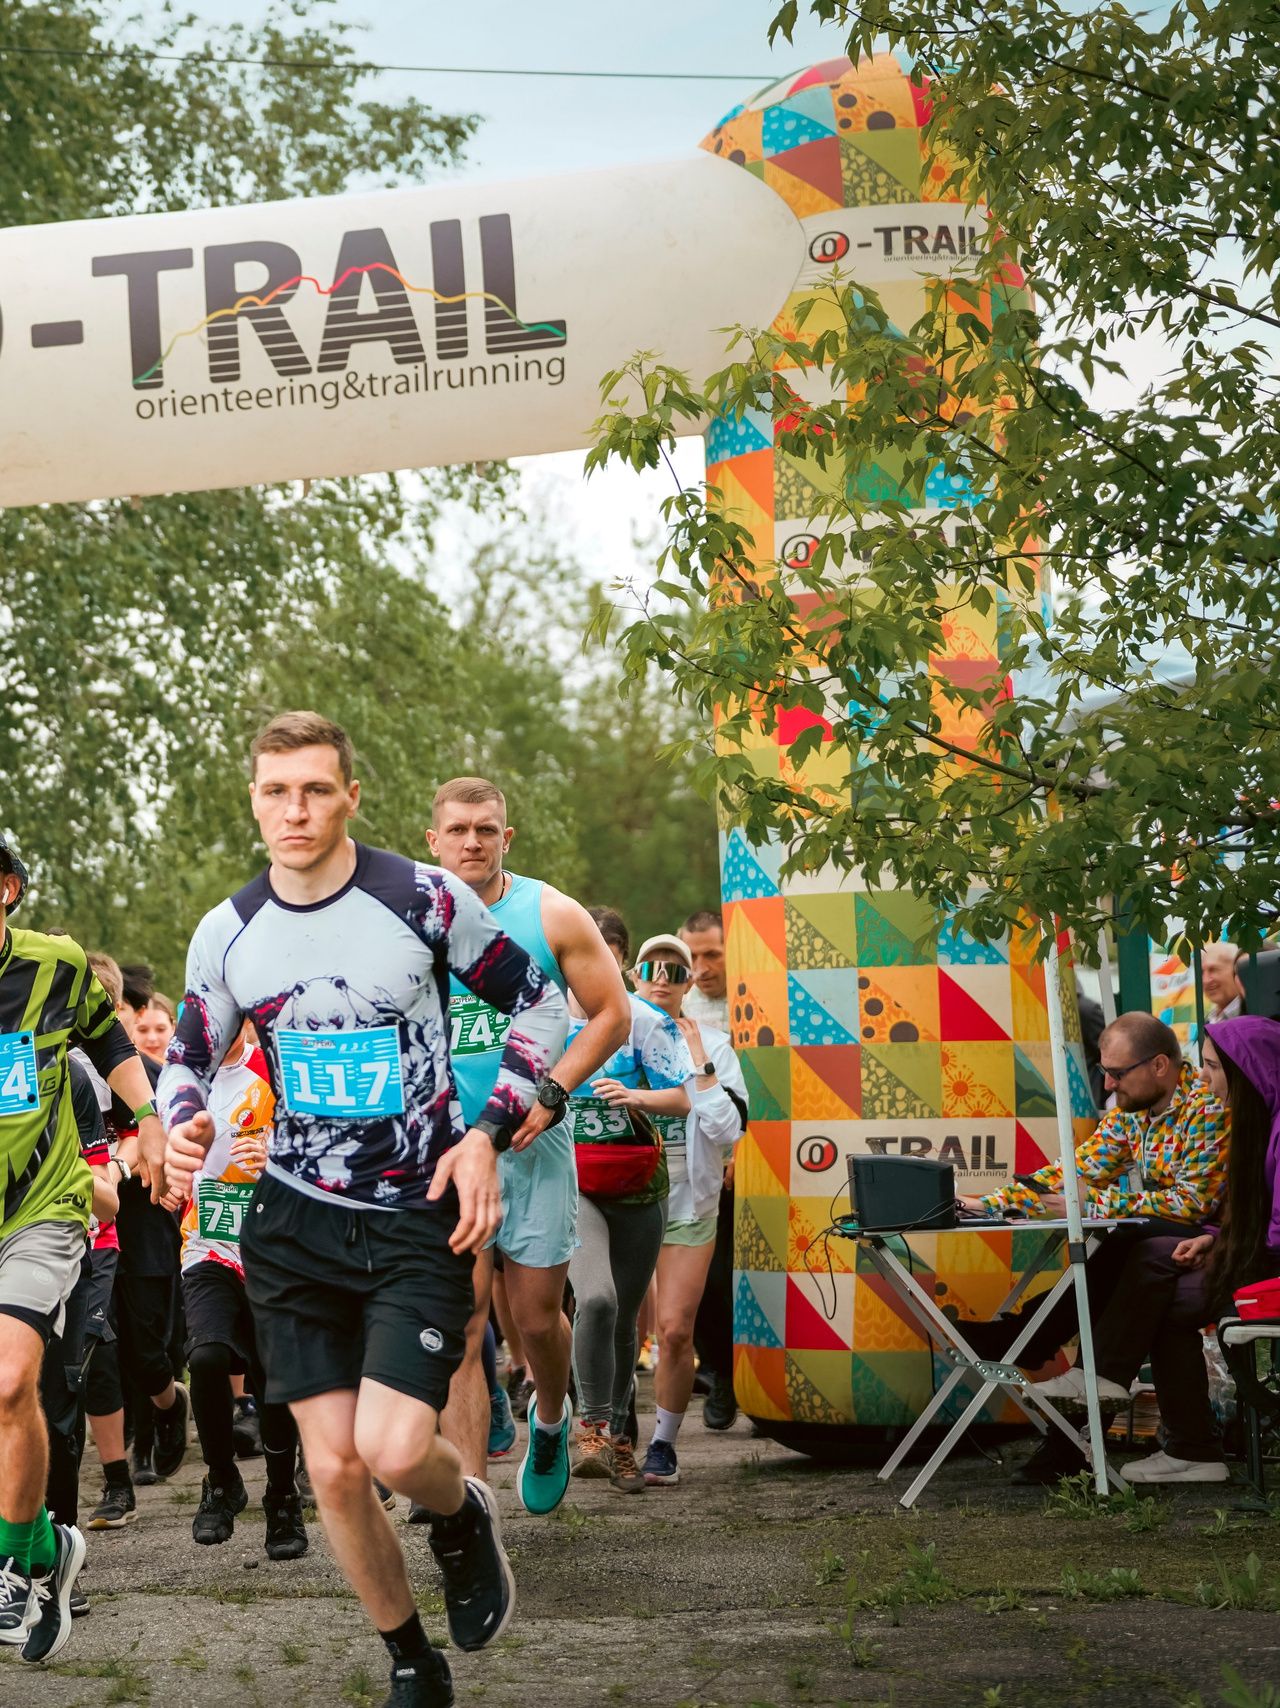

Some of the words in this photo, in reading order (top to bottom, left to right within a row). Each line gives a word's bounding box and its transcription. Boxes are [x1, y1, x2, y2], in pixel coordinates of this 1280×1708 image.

[135, 352, 566, 421] orienteering&trailrunning
[292, 1061, 390, 1106] 117
[571, 1109, 627, 1137] 33
[204, 1200, 242, 1236] 71
